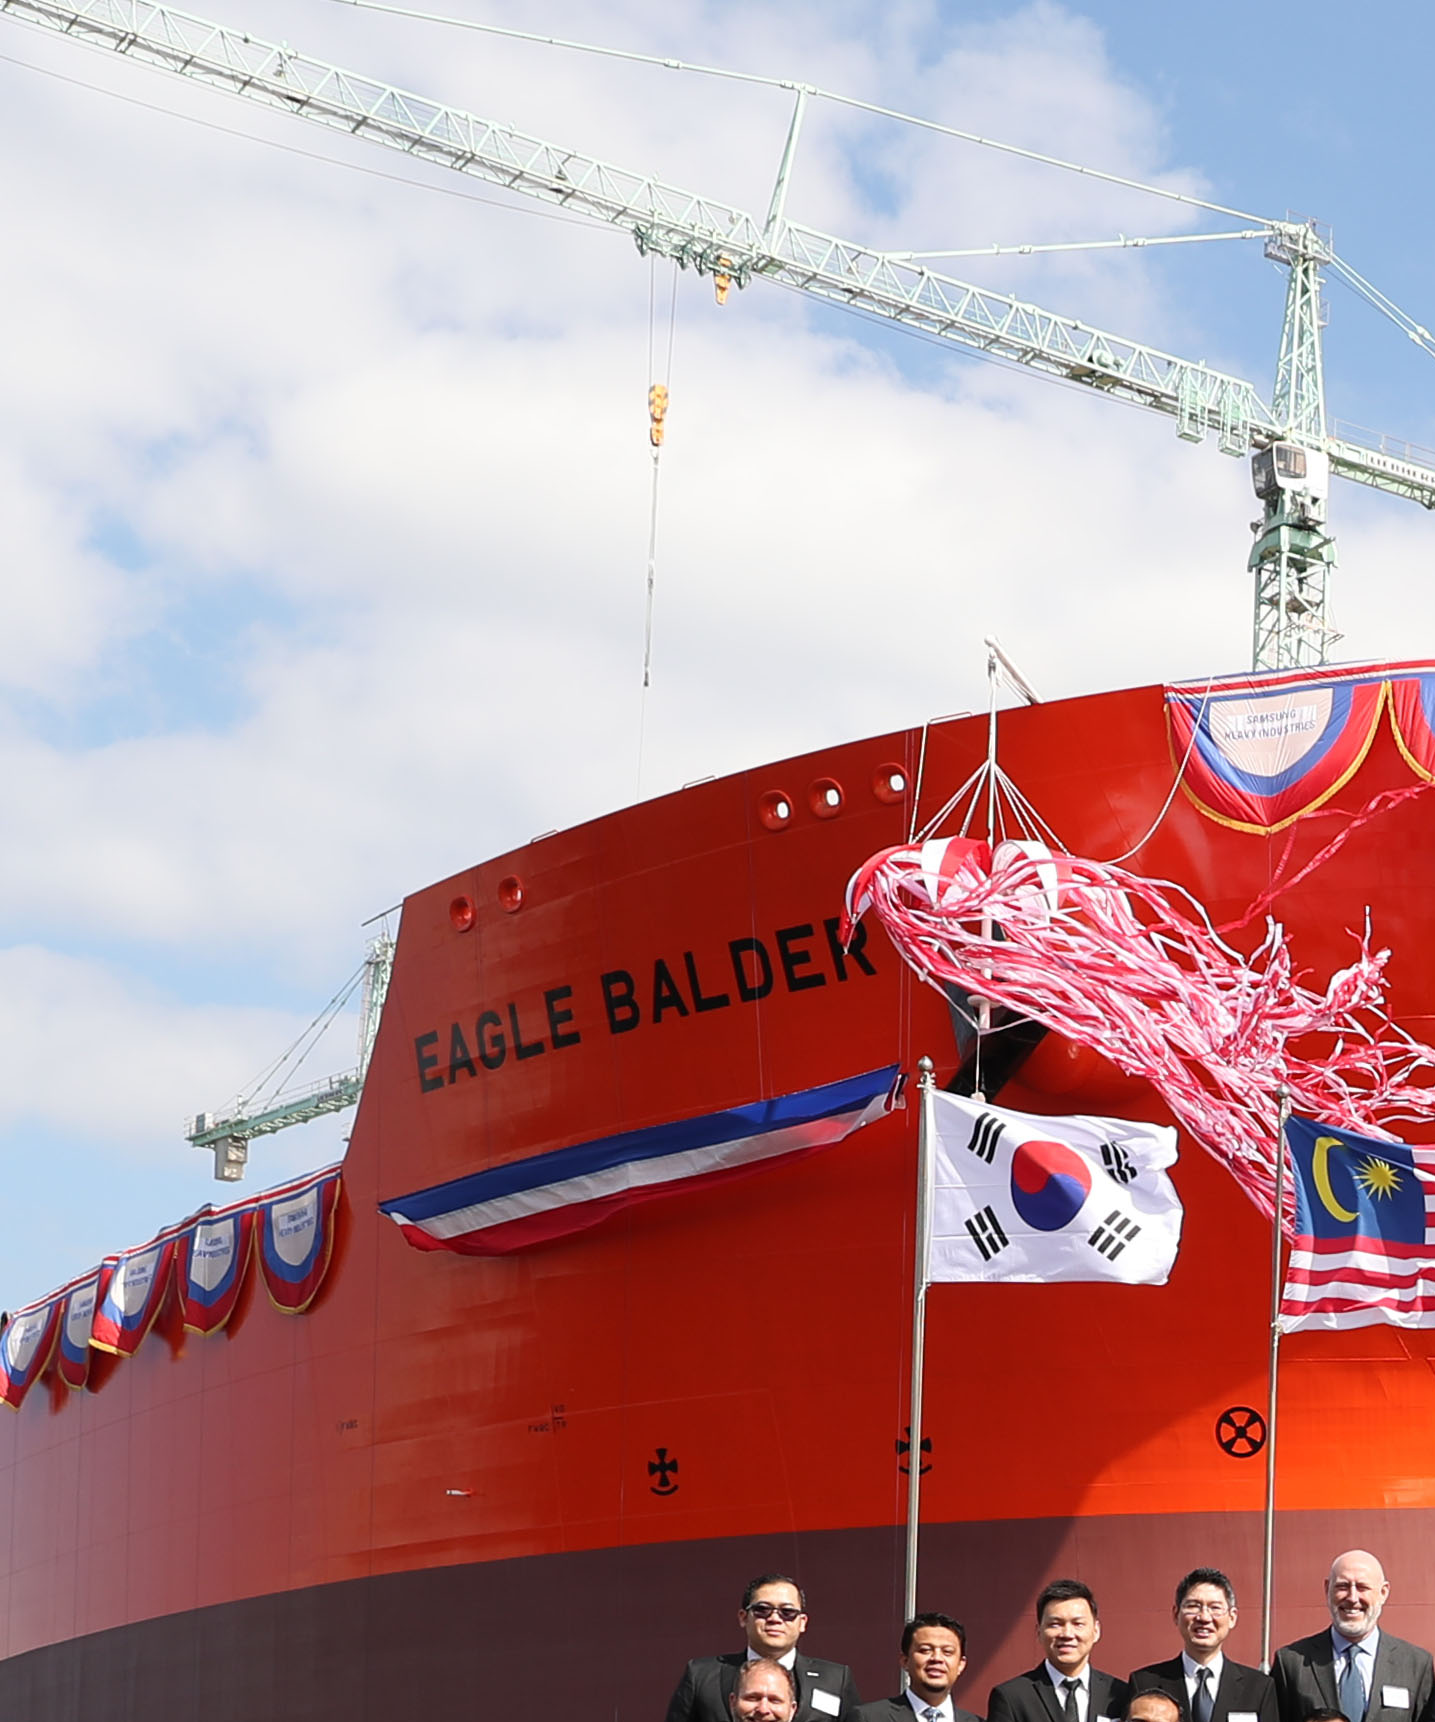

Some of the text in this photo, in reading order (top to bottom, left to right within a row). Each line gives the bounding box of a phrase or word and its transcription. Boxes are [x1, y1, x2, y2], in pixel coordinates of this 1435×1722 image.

[1247, 709, 1297, 725] SAMSUNG
[1224, 721, 1316, 740] HEAVY INDUSTRIES
[414, 917, 878, 1093] EAGLE BALDER
